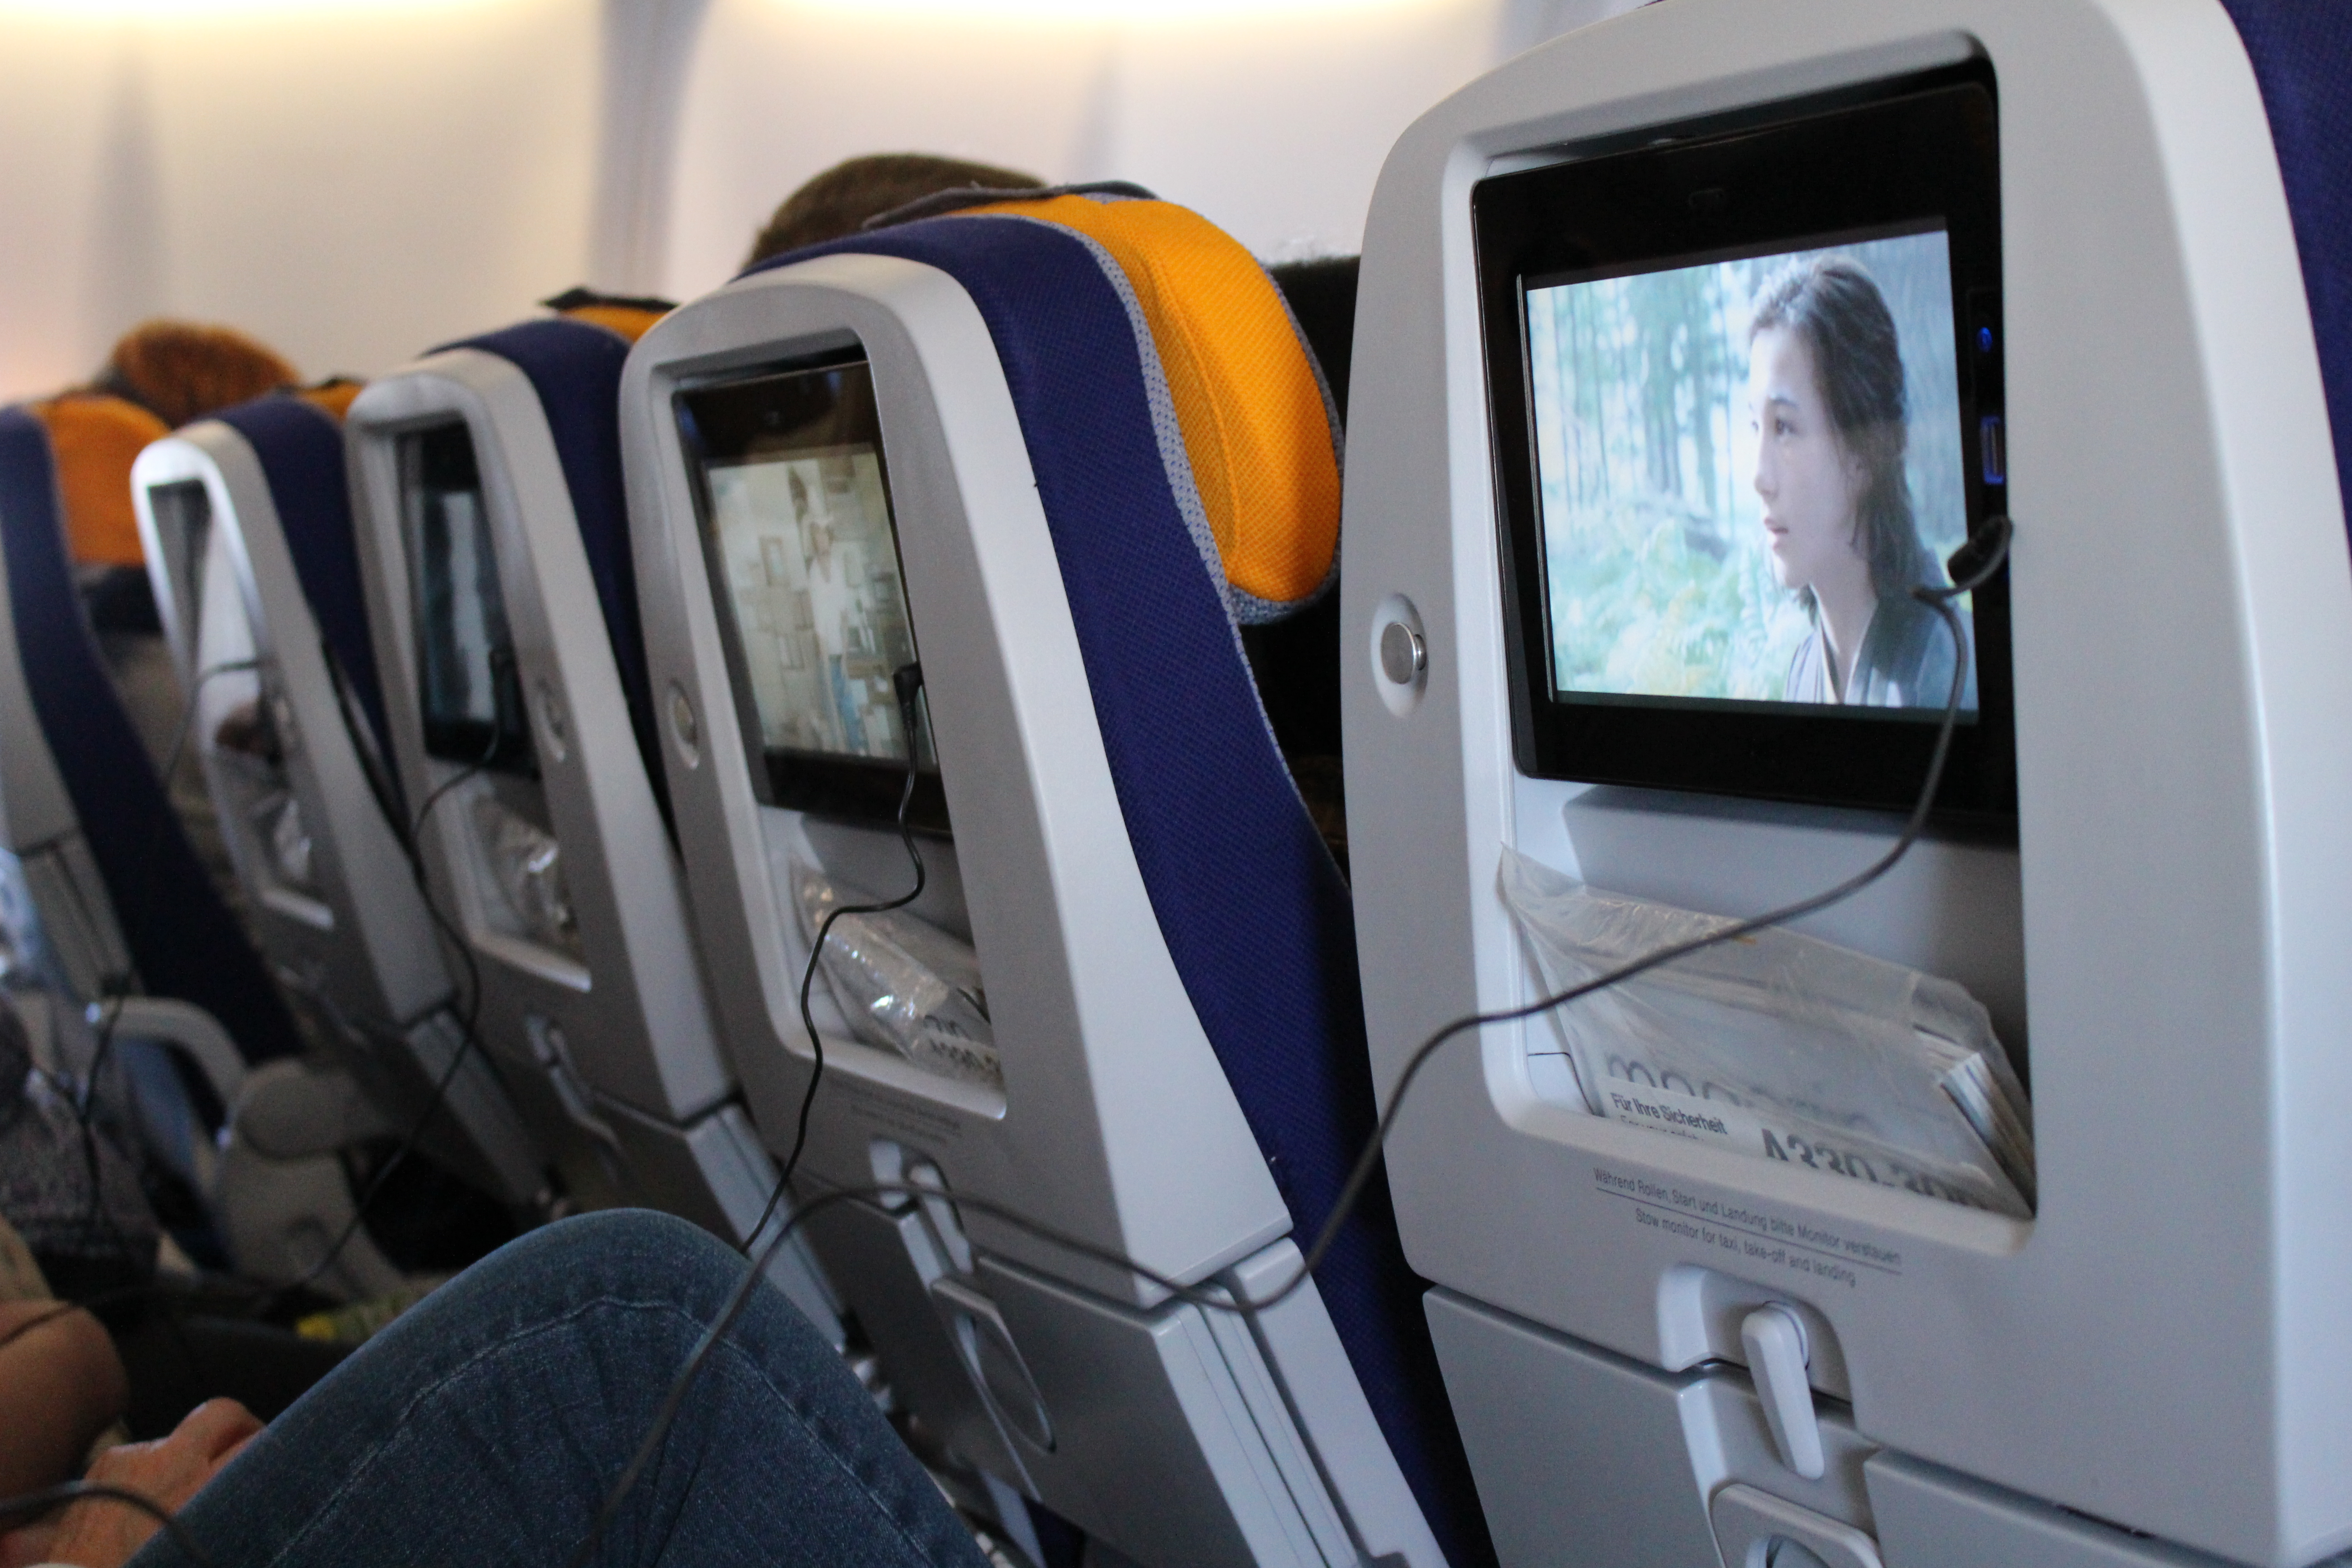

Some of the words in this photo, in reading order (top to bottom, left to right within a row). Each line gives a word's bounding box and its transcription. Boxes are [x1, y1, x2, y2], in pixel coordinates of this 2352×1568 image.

[1611, 1092, 1632, 1112] Für
[1632, 1098, 1661, 1119] Ihre
[1659, 1104, 1728, 1135] Sicherheit
[1593, 1167, 1635, 1192] Während
[1672, 1188, 1697, 1210] Start
[1700, 1200, 1718, 1215] und
[1721, 1204, 1767, 1231] Landung
[1797, 1223, 1840, 1247] Monitor
[1635, 1207, 1659, 1227] Stow
[1662, 1218, 1699, 1239] monitor
[1702, 1226, 1715, 1243] for
[1744, 1239, 1786, 1264] take-off
[1789, 1255, 1811, 1272] and
[1813, 1259, 1856, 1288] landing
